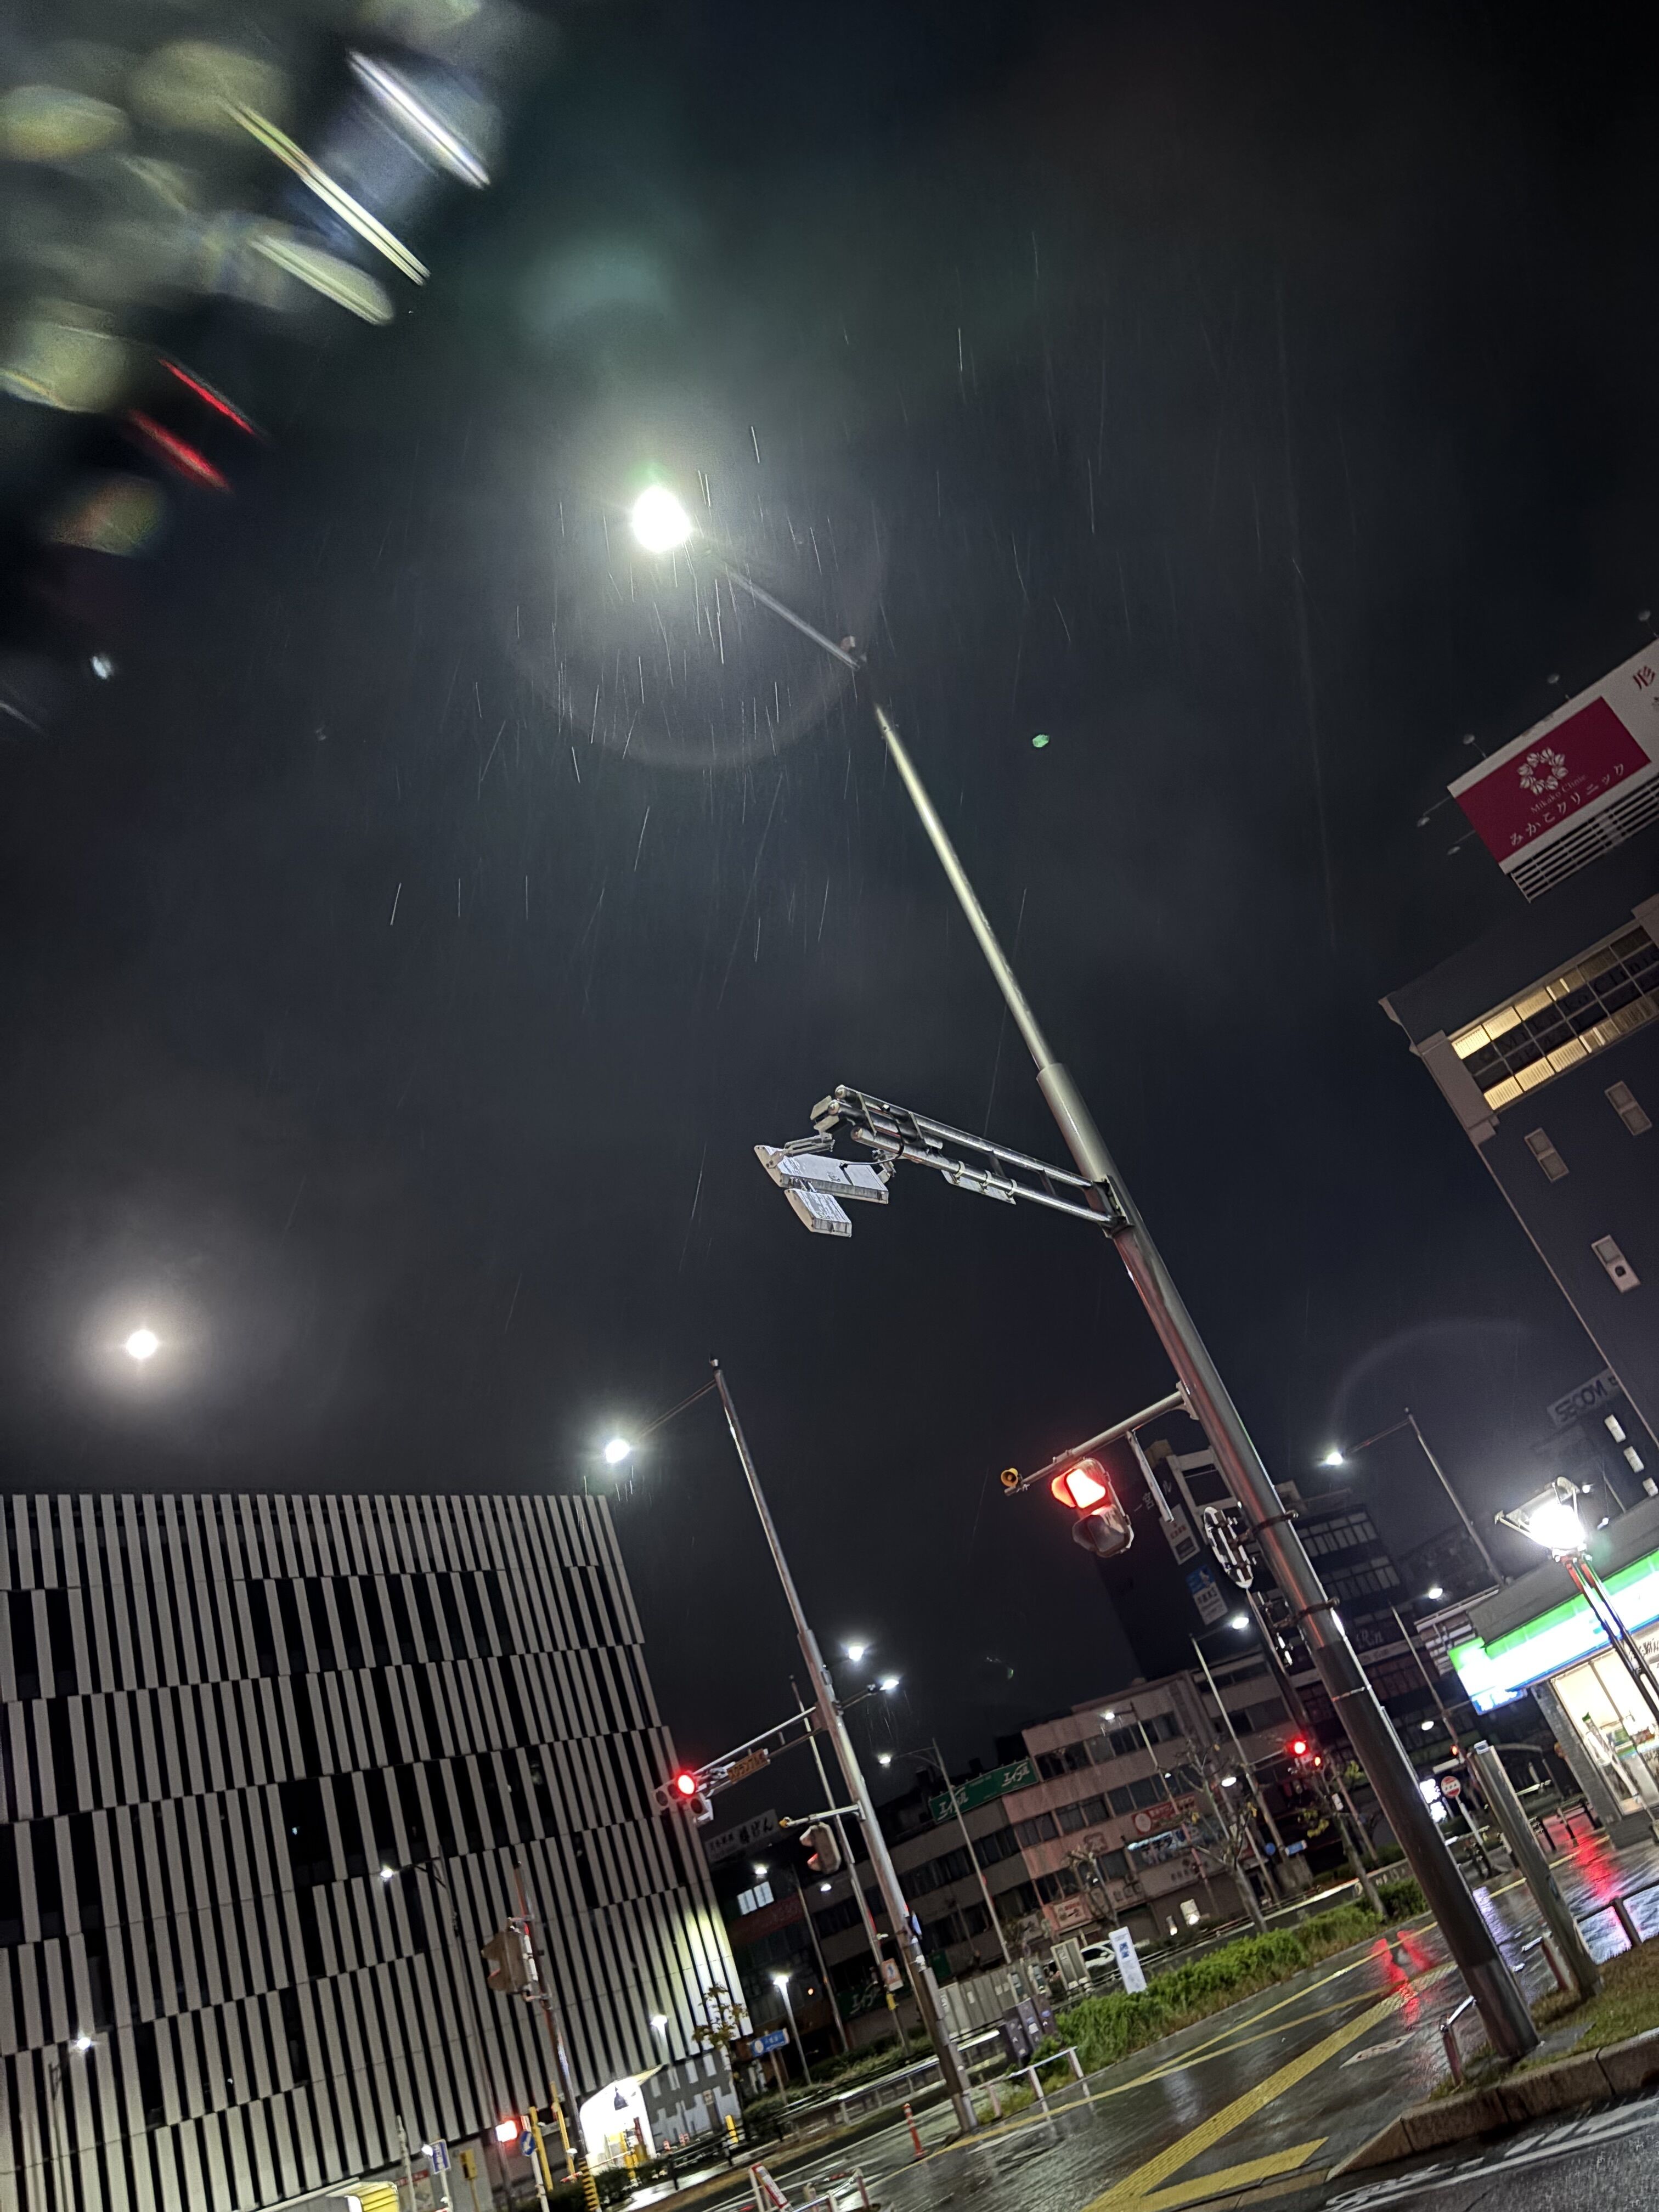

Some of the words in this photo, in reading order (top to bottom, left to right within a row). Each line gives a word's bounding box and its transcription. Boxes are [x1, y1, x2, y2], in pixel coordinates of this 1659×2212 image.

[1510, 763, 1624, 845] みかこクリニック
[1531, 791, 1561, 814] Mikako
[1562, 775, 1587, 793] Clinic
[1555, 1379, 1608, 1423] SECOM
